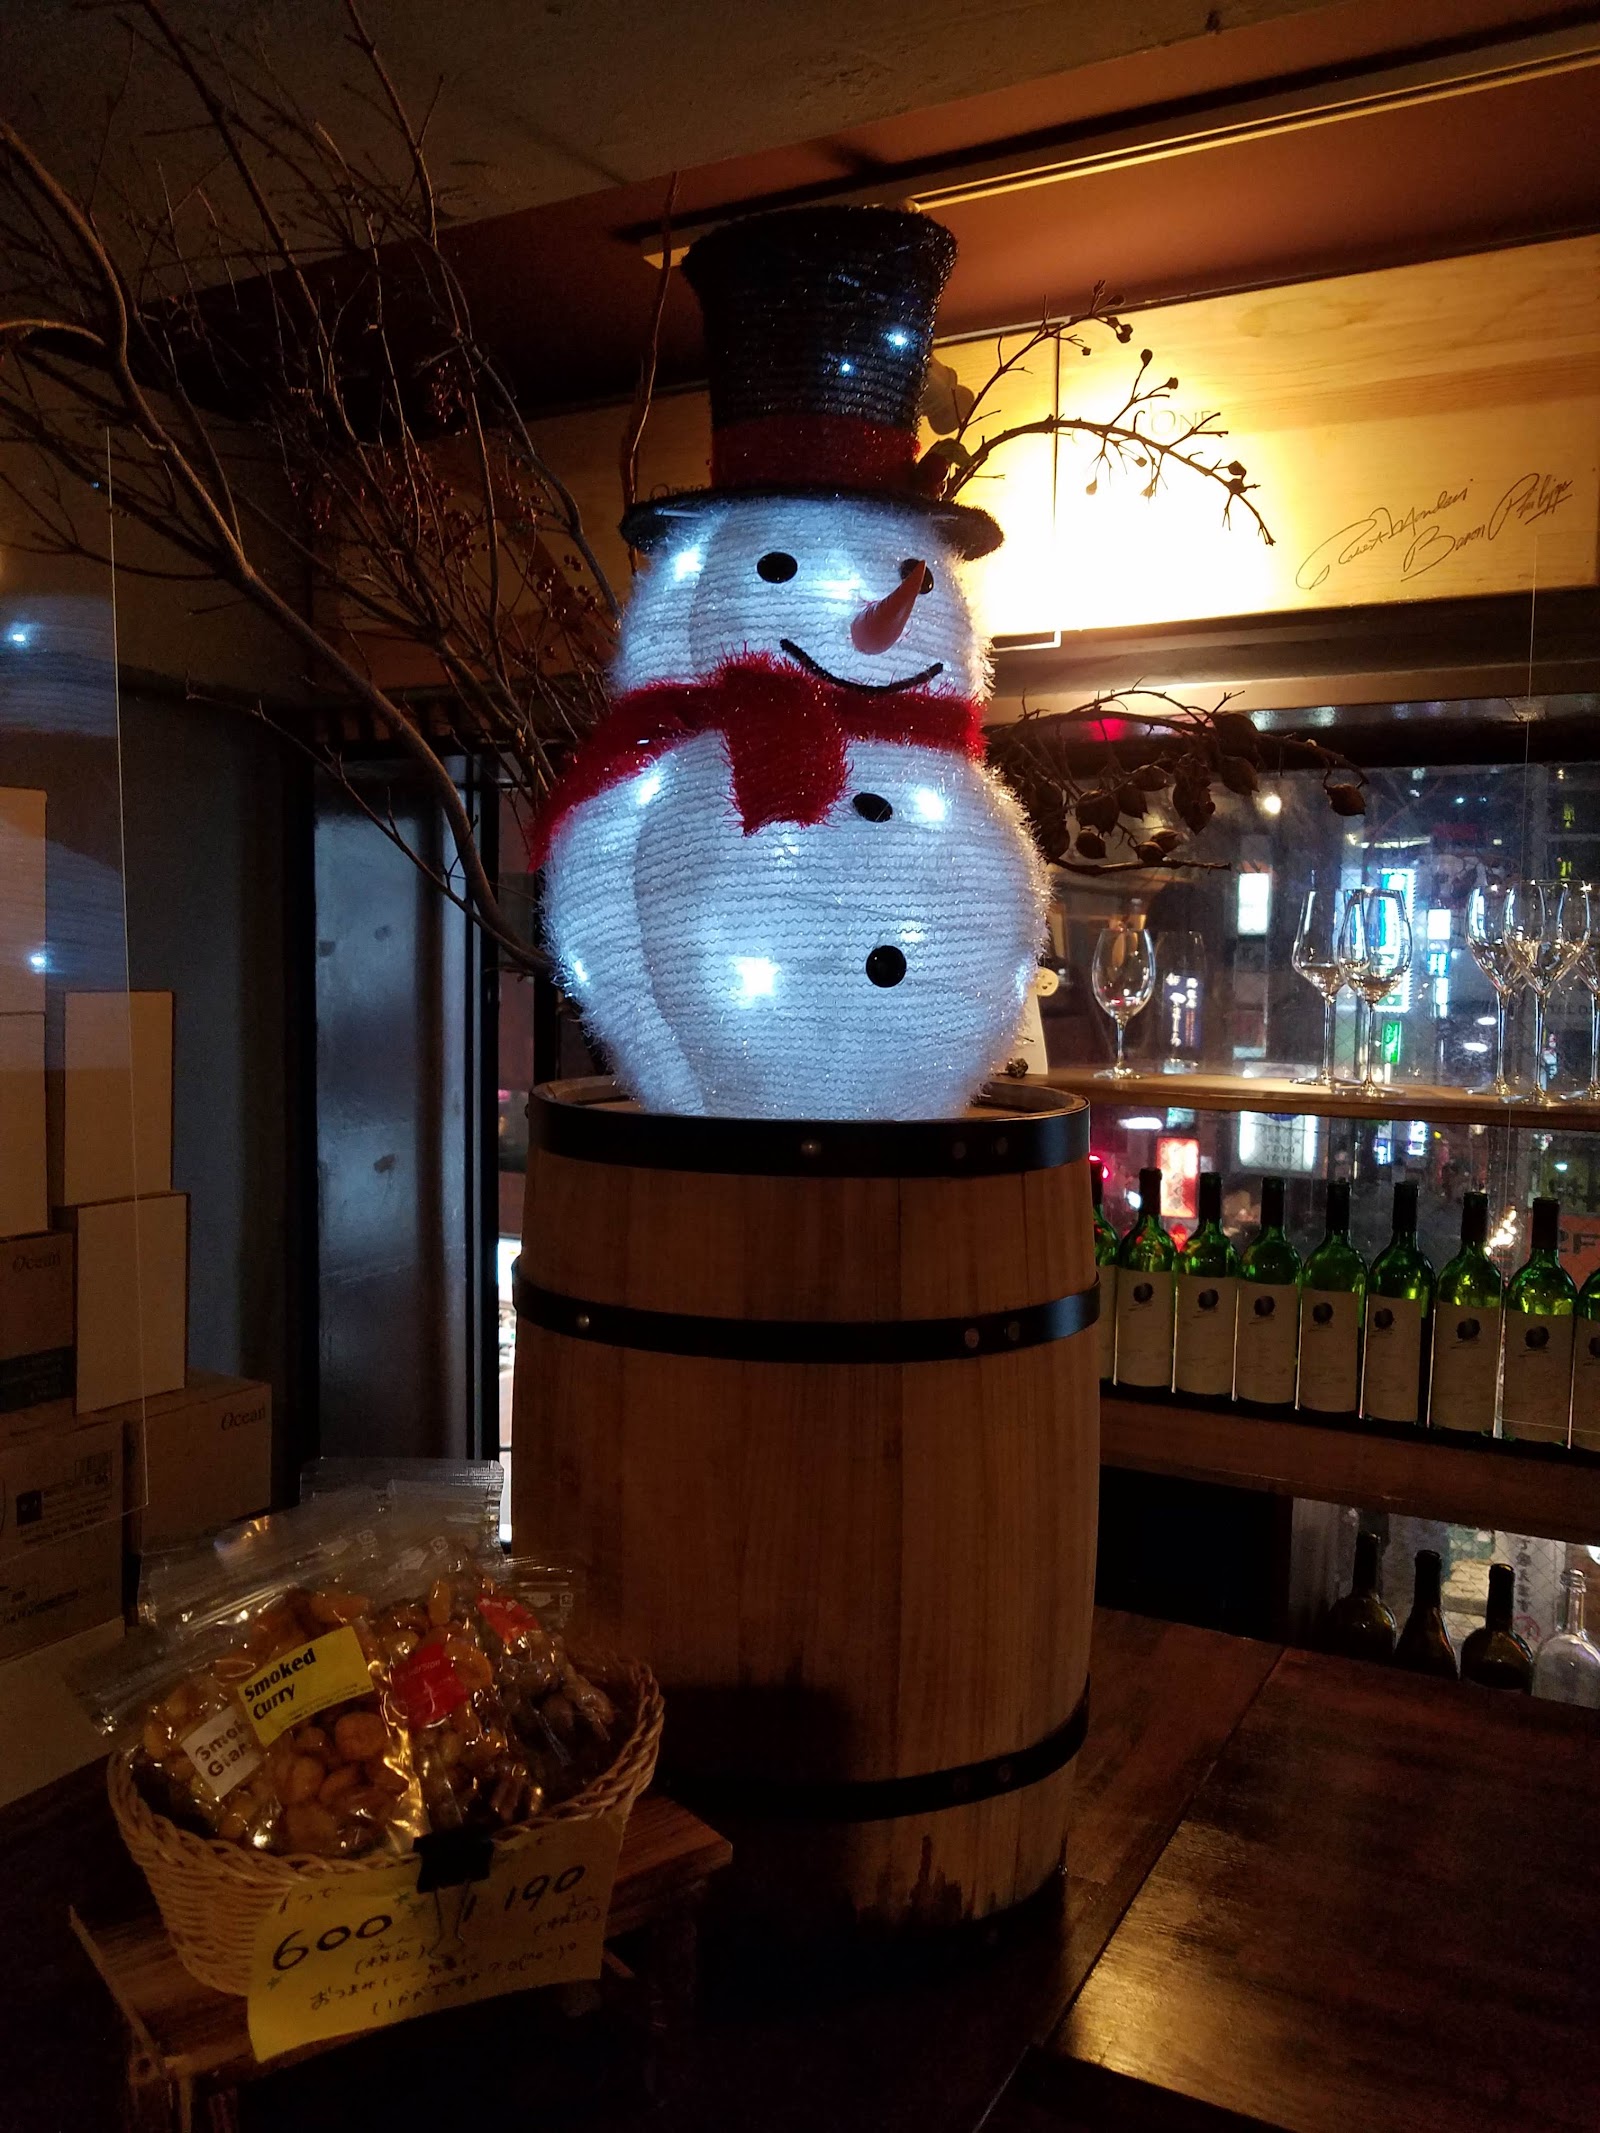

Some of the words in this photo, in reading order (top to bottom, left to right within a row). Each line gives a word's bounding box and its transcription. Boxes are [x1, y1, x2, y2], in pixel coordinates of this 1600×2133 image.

[1400, 526, 1486, 582] Baron
[221, 1406, 266, 1431] Ocean
[244, 1647, 316, 1702] Smoked
[252, 1683, 295, 1720] Curry
[272, 1914, 393, 1971] 600
